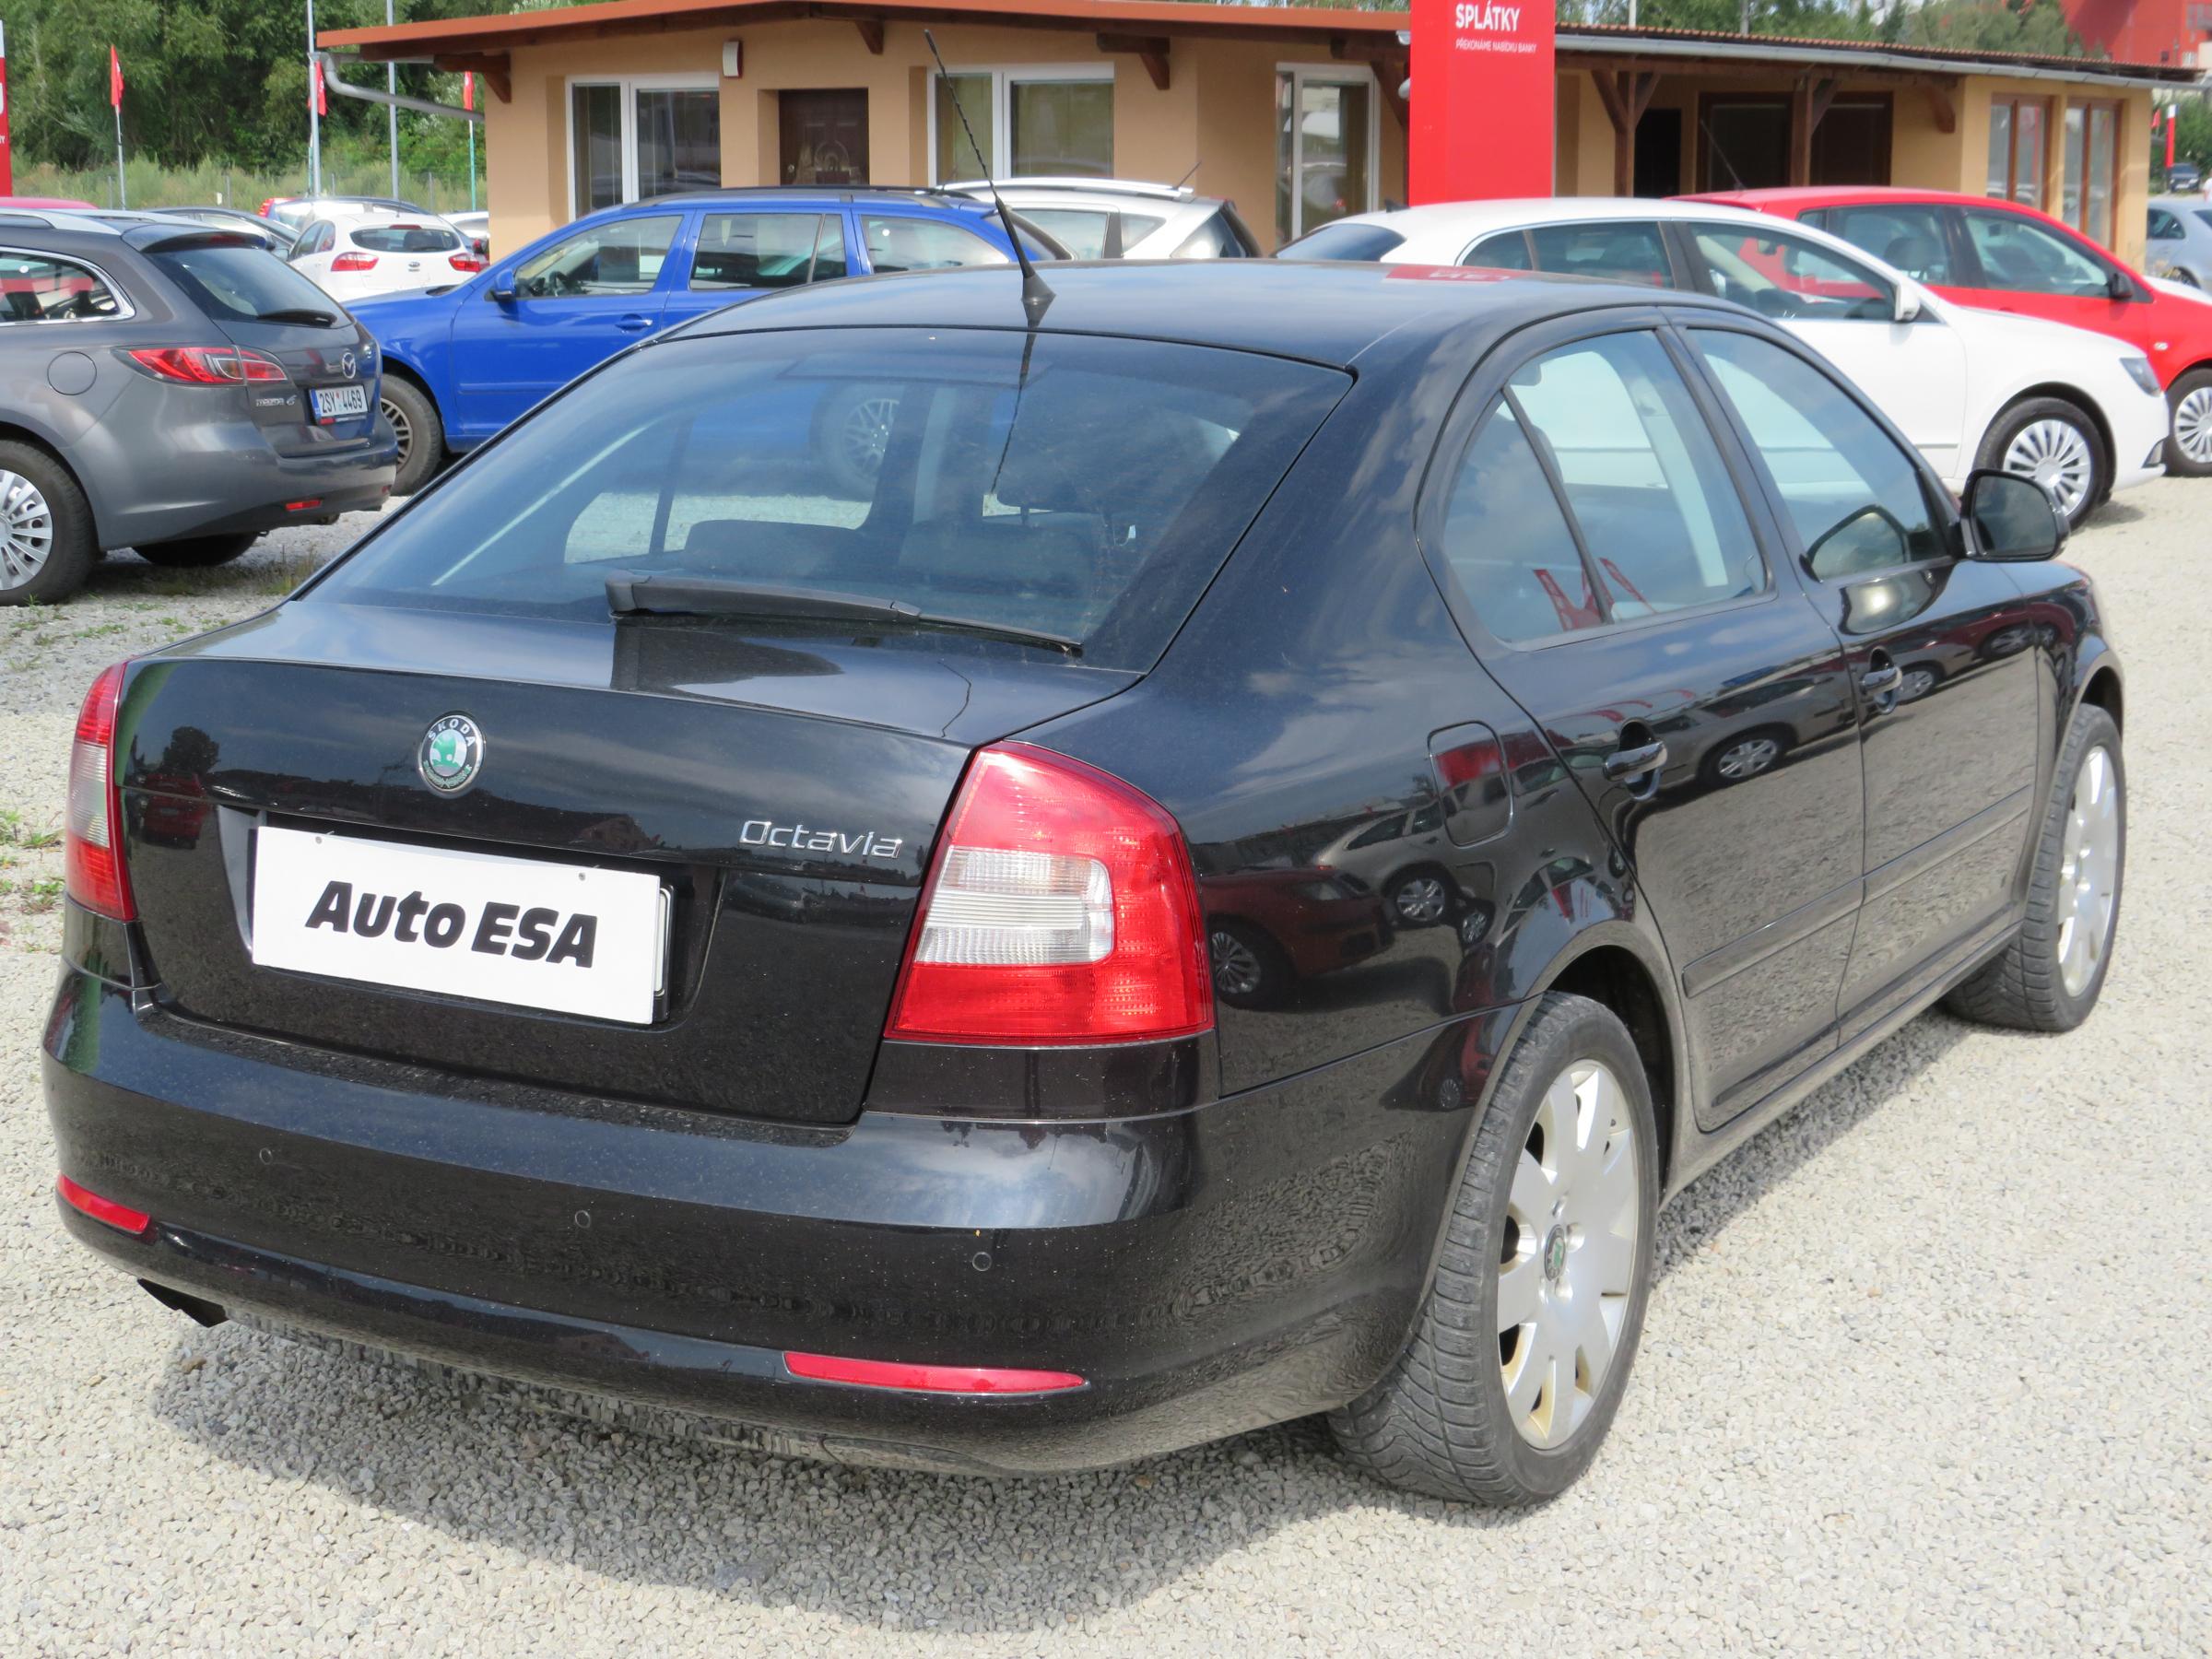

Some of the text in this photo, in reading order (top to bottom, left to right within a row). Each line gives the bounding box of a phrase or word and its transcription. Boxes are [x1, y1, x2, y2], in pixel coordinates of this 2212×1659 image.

[1455, 0, 1521, 31] SPLÁTKY
[319, 389, 363, 413] 2SY 4469
[739, 819, 903, 859] Octavia
[304, 880, 598, 969] Auto ESA
